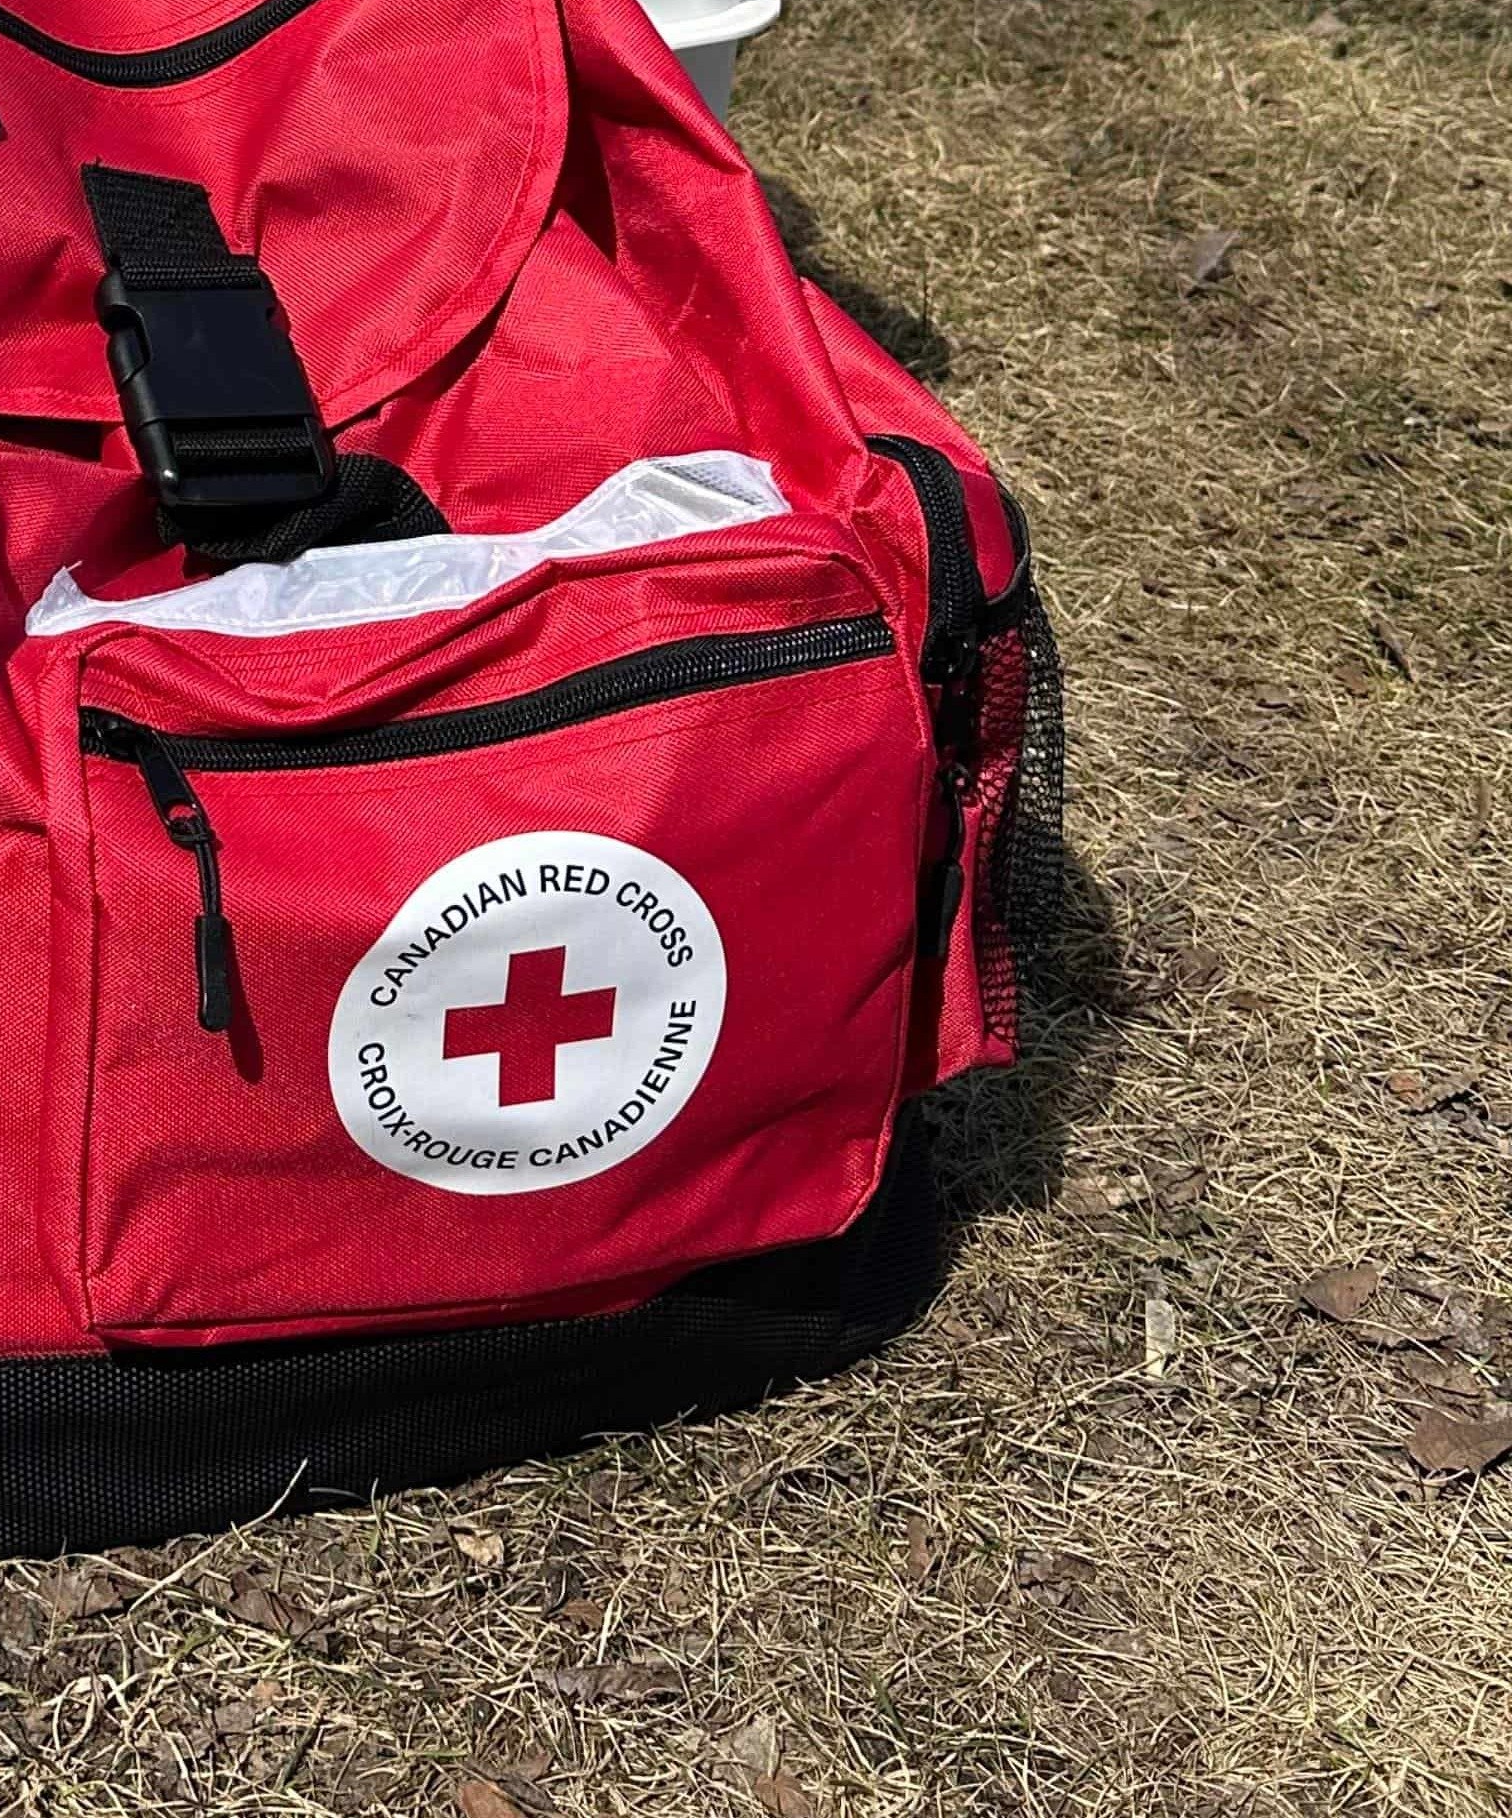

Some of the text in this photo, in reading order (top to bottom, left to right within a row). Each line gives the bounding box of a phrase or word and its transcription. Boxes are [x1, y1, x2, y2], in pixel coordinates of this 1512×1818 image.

[369, 863, 694, 1008] CANADIAN RED CROSS
[357, 998, 698, 1171] CROIX-ROUGE CANADIENNE
